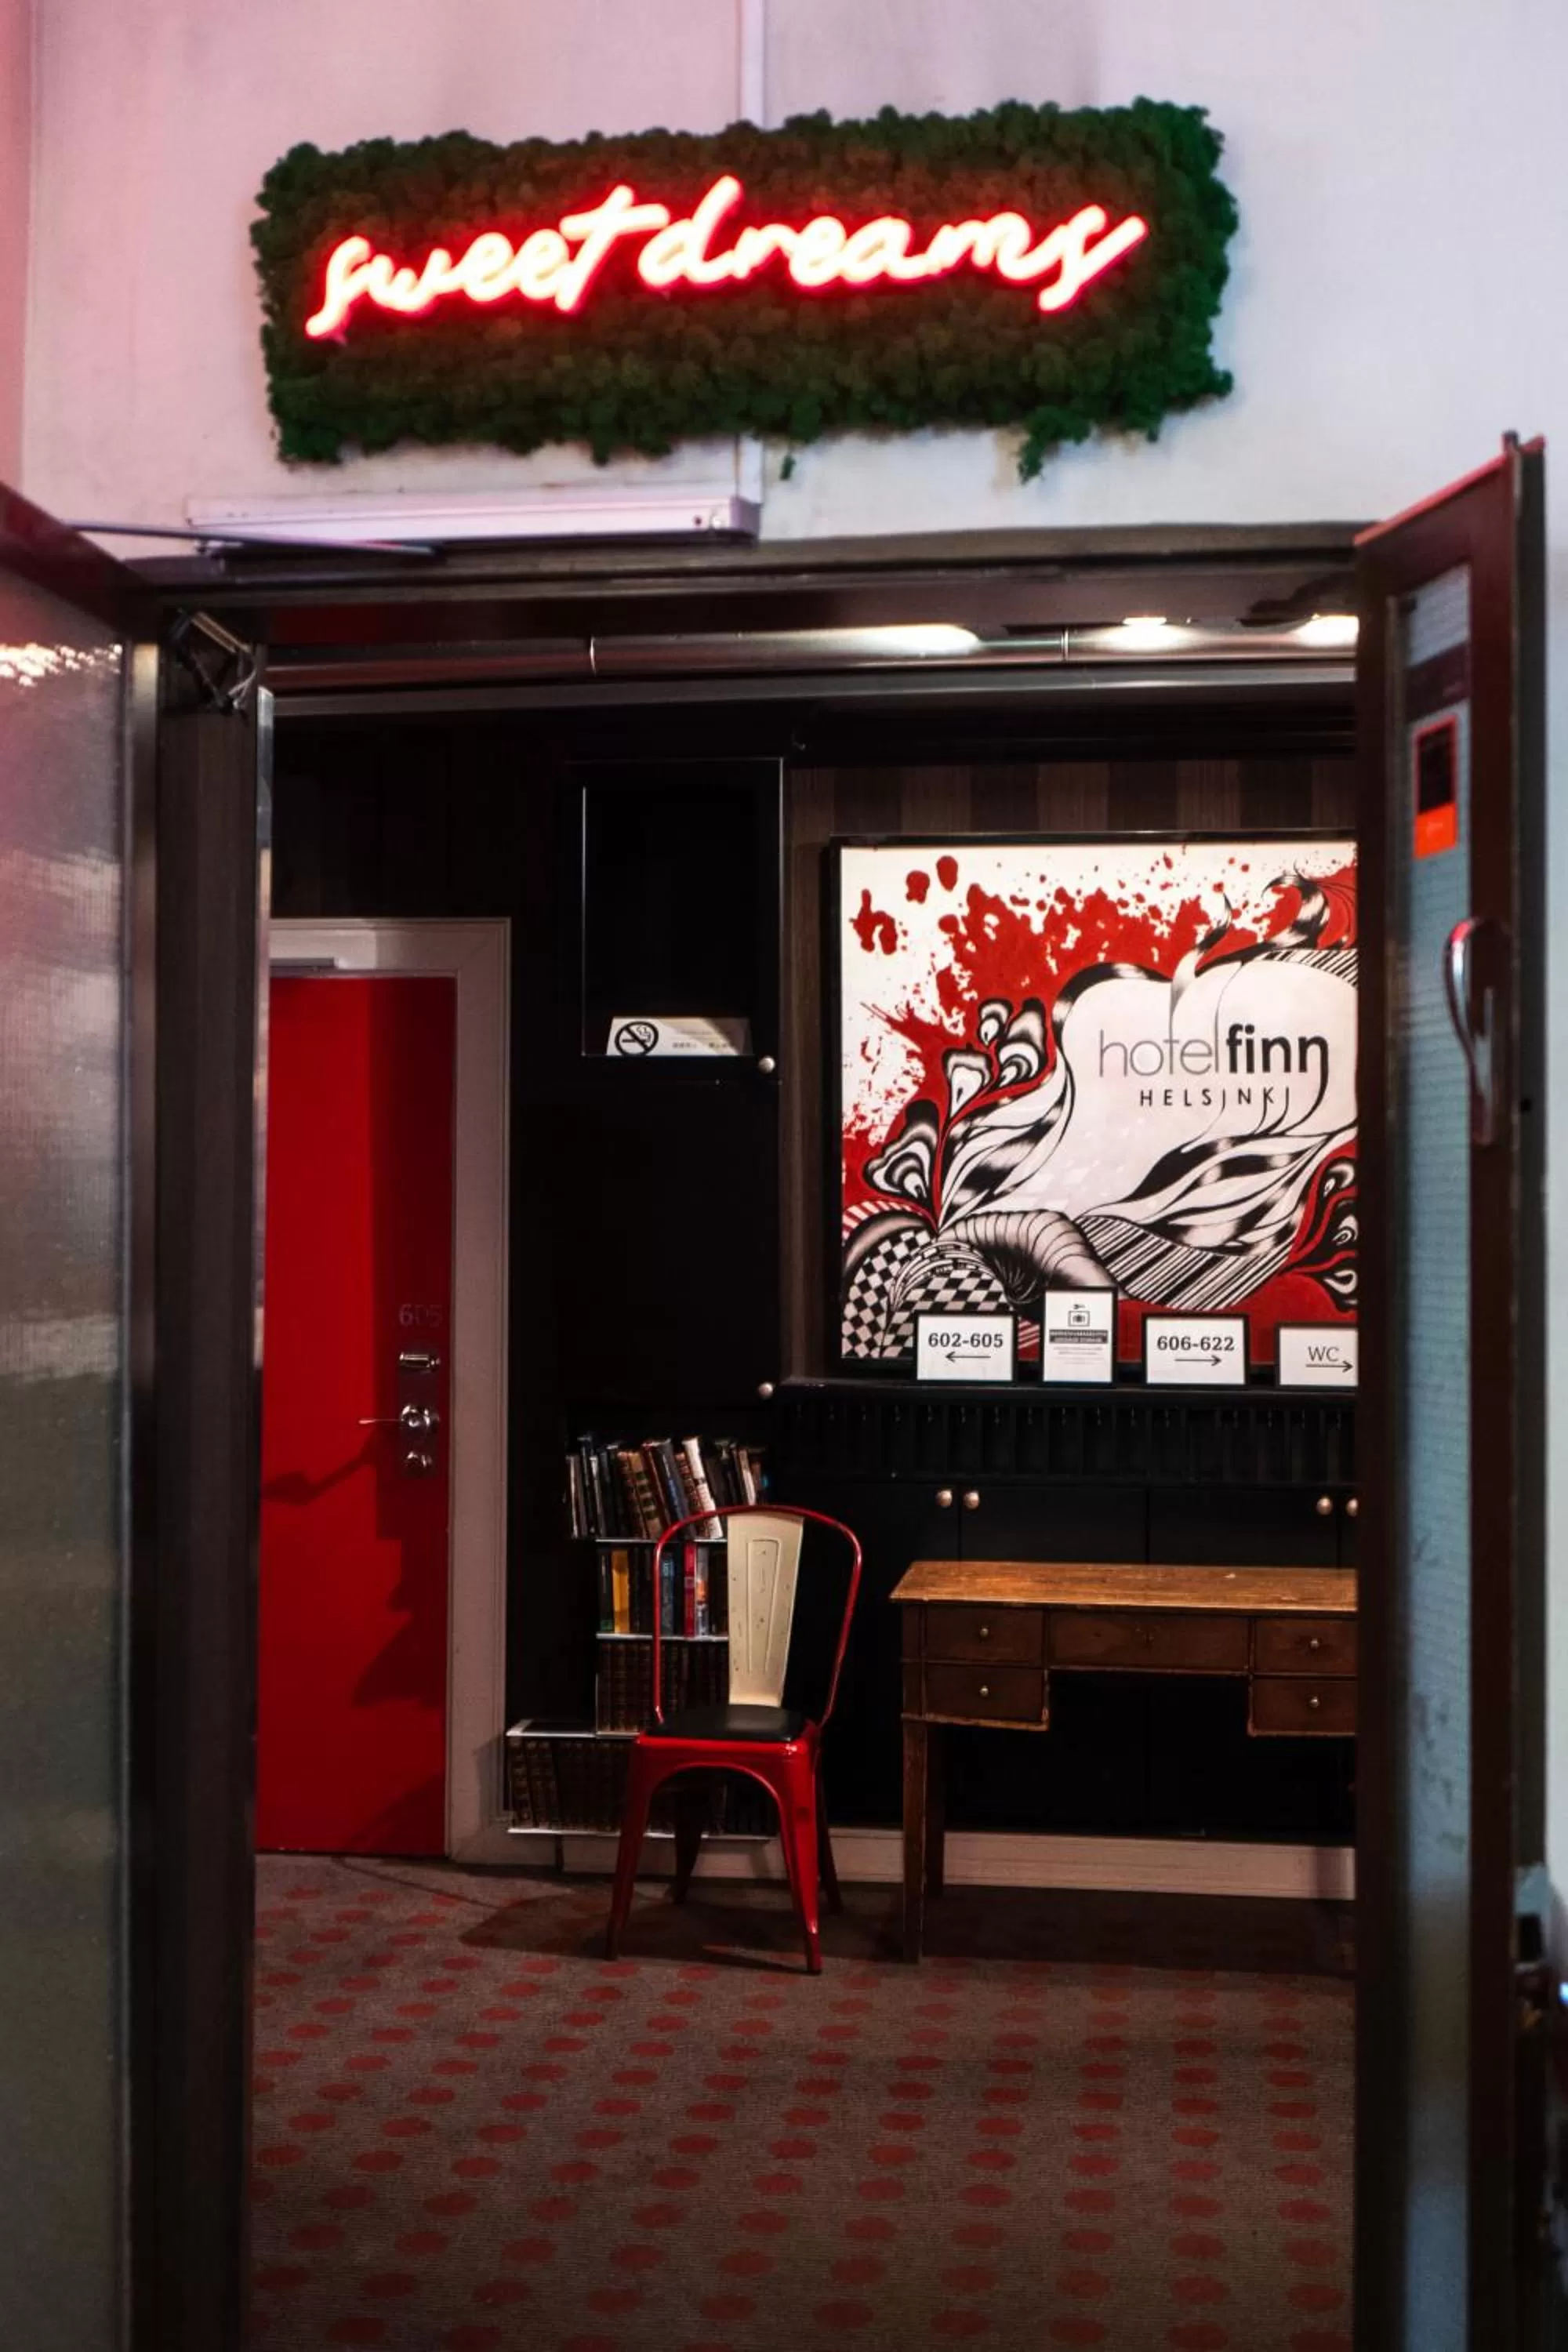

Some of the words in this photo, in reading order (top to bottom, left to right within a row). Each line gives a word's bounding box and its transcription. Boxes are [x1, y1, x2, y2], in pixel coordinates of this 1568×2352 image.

[306, 185, 669, 339] sweet
[637, 176, 1147, 313] dreams
[1139, 1087, 1290, 1111] HELSINKI
[927, 1332, 1004, 1348] 602-605
[1156, 1335, 1236, 1352] 606-622
[1307, 1345, 1340, 1363] WC
